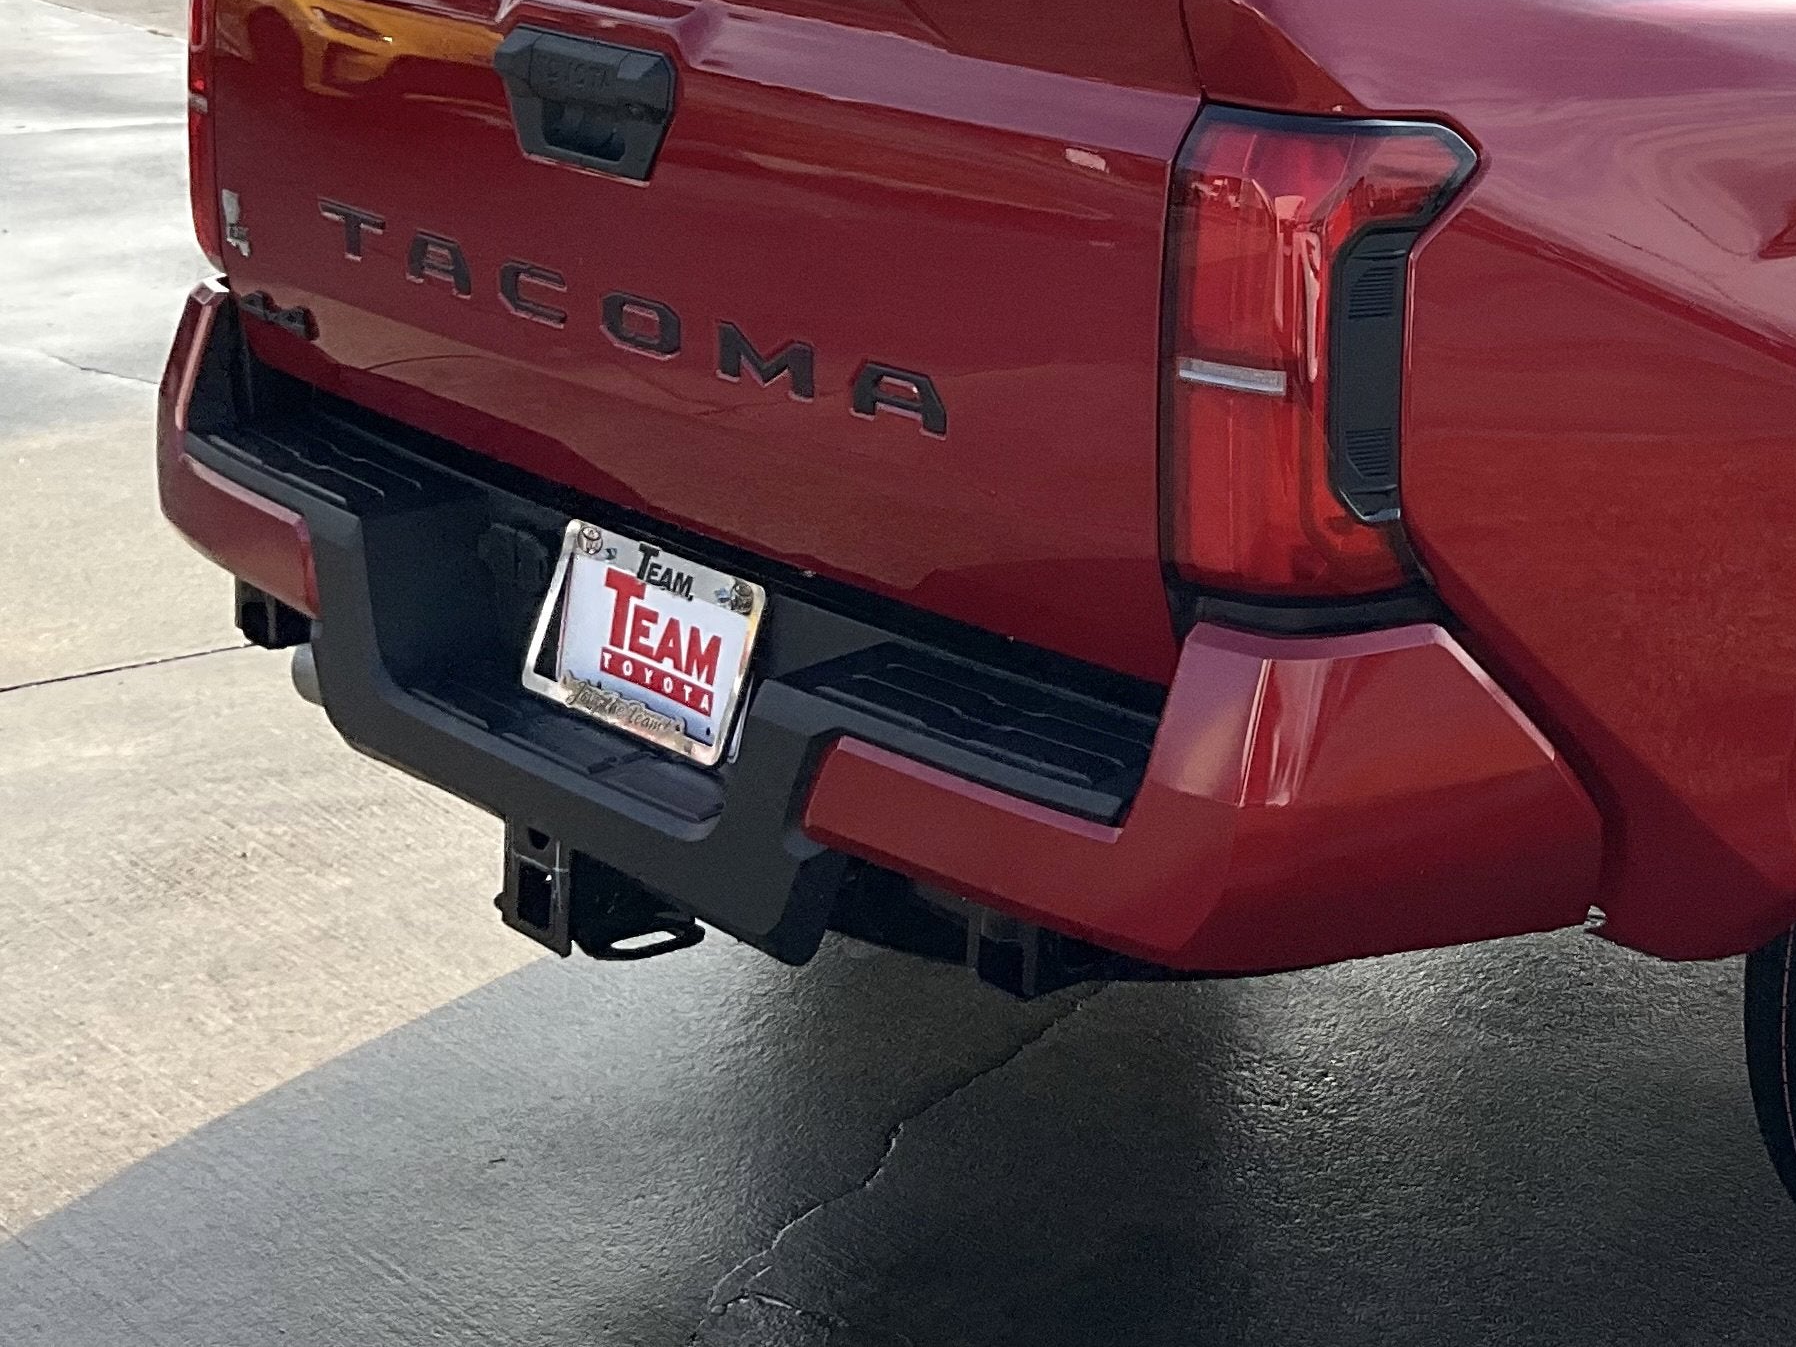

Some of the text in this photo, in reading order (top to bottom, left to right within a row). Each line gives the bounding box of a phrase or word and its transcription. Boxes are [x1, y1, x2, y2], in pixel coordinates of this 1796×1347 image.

[317, 195, 948, 440] TACOMA
[602, 651, 710, 714] TOYOTA
[605, 568, 722, 687] TEAM
